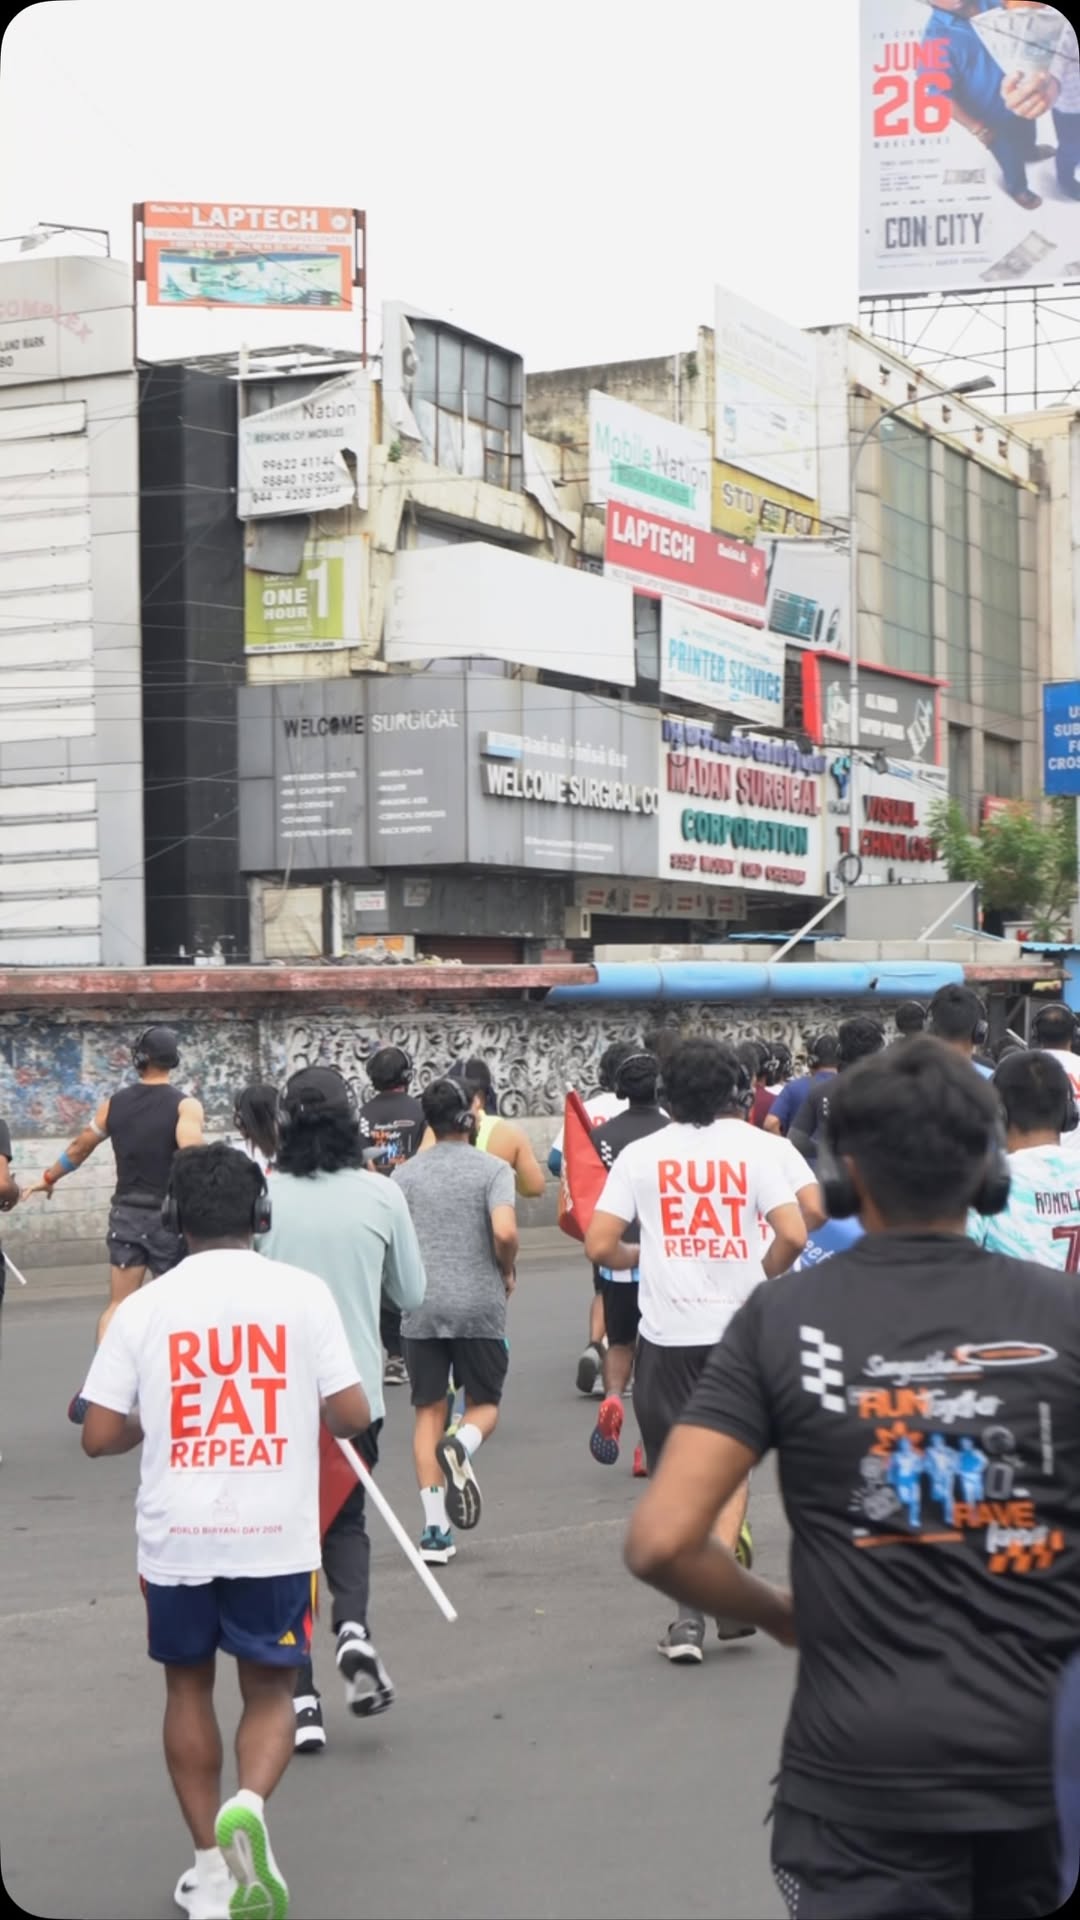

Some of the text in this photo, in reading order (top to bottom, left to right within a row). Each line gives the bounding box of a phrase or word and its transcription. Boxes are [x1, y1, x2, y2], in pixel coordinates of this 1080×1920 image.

[873, 38, 951, 73] JUNE
[873, 73, 953, 137] 26
[192, 206, 319, 230] LAPTECH
[885, 212, 984, 249] CON CITY
[302, 401, 356, 420] Nation
[596, 422, 709, 491] Mobile Nation
[612, 511, 695, 563] LAPTECH
[263, 588, 307, 606] ONE
[307, 560, 328, 618] 1
[264, 606, 308, 620] HOUR
[668, 638, 725, 684] PRINTER
[729, 659, 781, 704] SERVICE
[284, 709, 458, 738] WELCOME SURGICAL
[486, 763, 566, 803] WELCOME
[570, 776, 640, 812] SURGICAL
[667, 753, 820, 817] MADAN SURGICAL
[681, 808, 808, 856] CORPORATION
[657, 1160, 747, 1195] RUN
[660, 1196, 747, 1236] EAT
[664, 1238, 748, 1259] REPEAT
[169, 1323, 287, 1382] RUN
[171, 1378, 287, 1440] EAT
[170, 1438, 288, 1468] REPEAT
